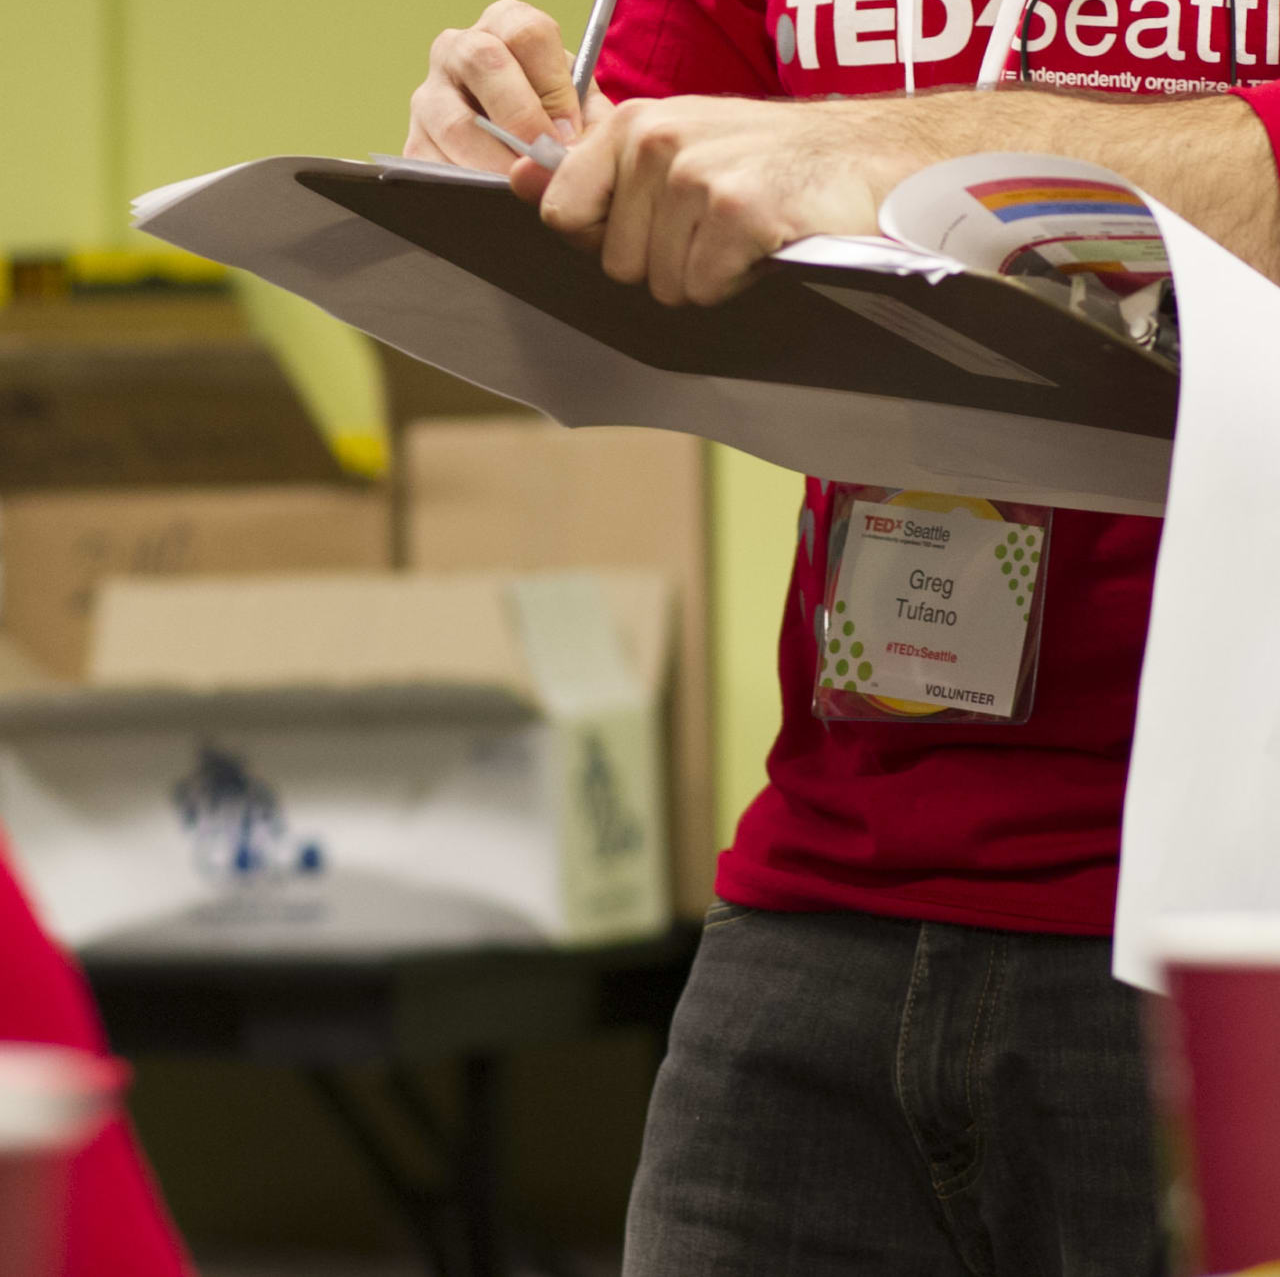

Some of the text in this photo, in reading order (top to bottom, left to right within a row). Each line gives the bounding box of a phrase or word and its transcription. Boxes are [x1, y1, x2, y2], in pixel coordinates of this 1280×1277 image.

[909, 569, 954, 600] Greg
[896, 598, 957, 626] Tufano
[885, 641, 958, 664] #TEDxSeattle
[925, 683, 995, 706] VOLUNTEER
